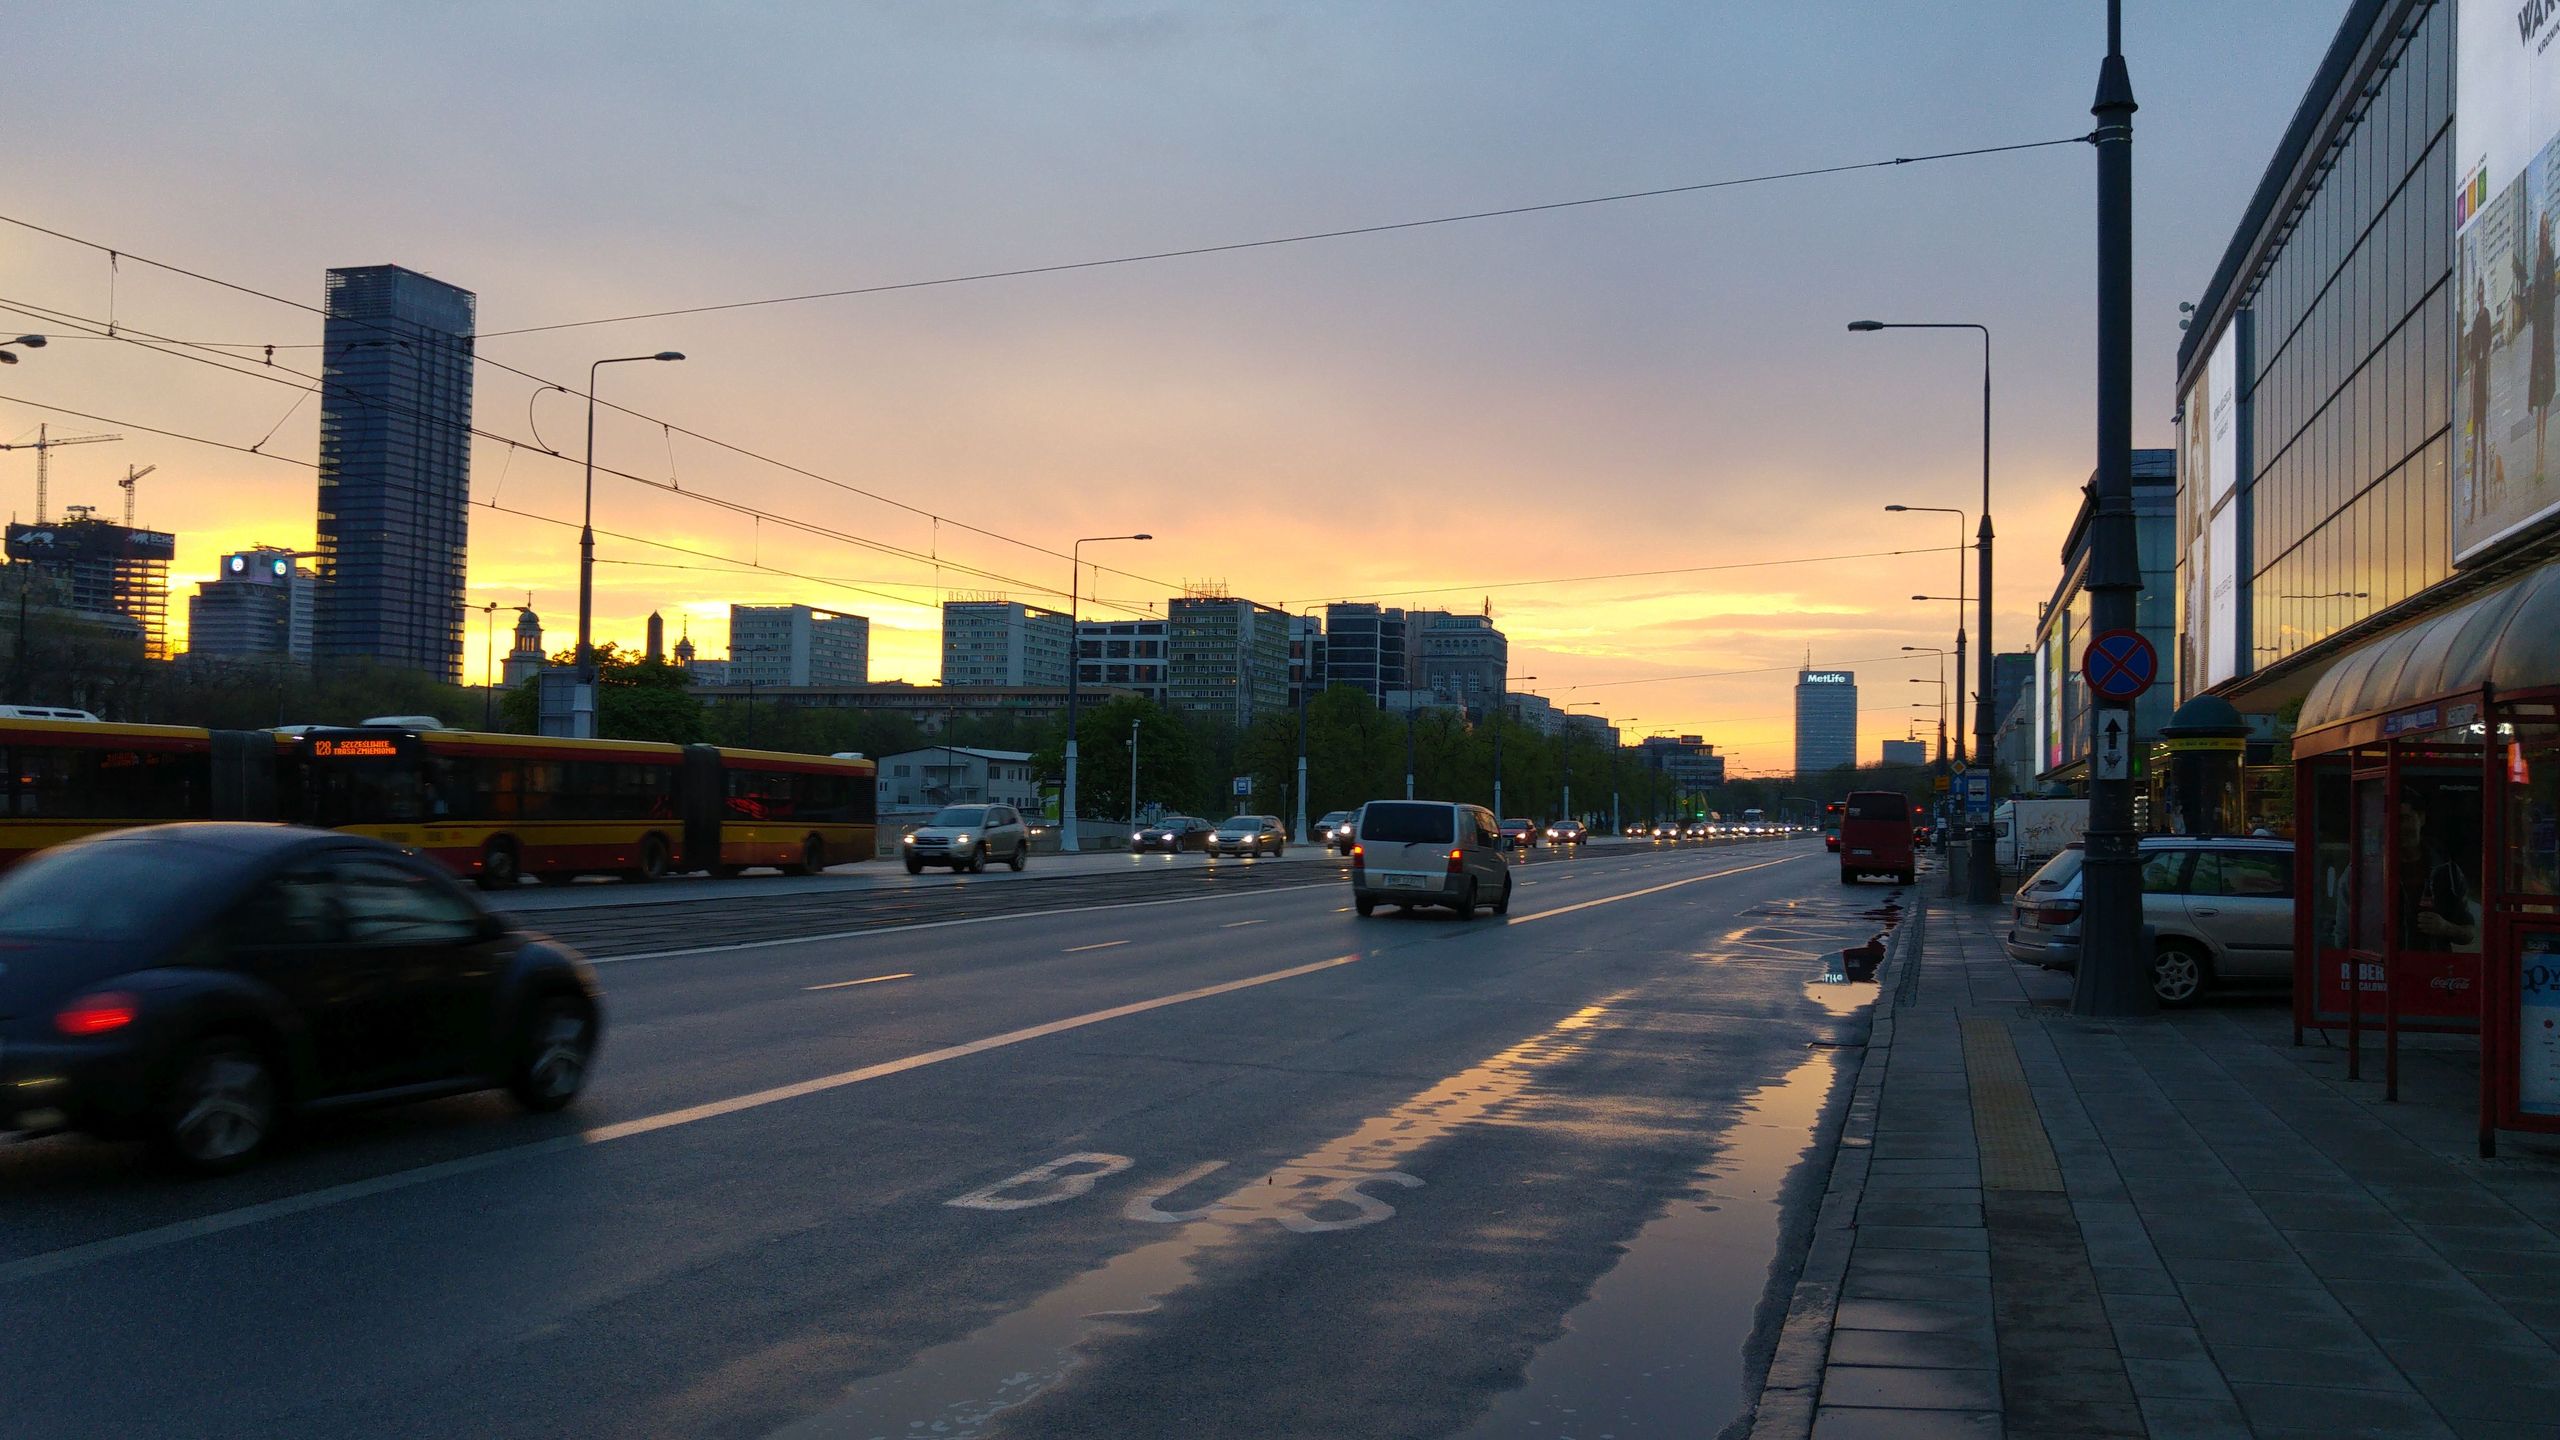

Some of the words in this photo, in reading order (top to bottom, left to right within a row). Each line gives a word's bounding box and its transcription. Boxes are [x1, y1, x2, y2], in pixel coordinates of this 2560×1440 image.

[2518, 0, 2560, 48] WAR
[1807, 674, 1846, 683] MetLife
[315, 741, 331, 755] 128
[2430, 976, 2472, 991] Coca-Cola
[941, 1151, 1425, 1234] BUS
